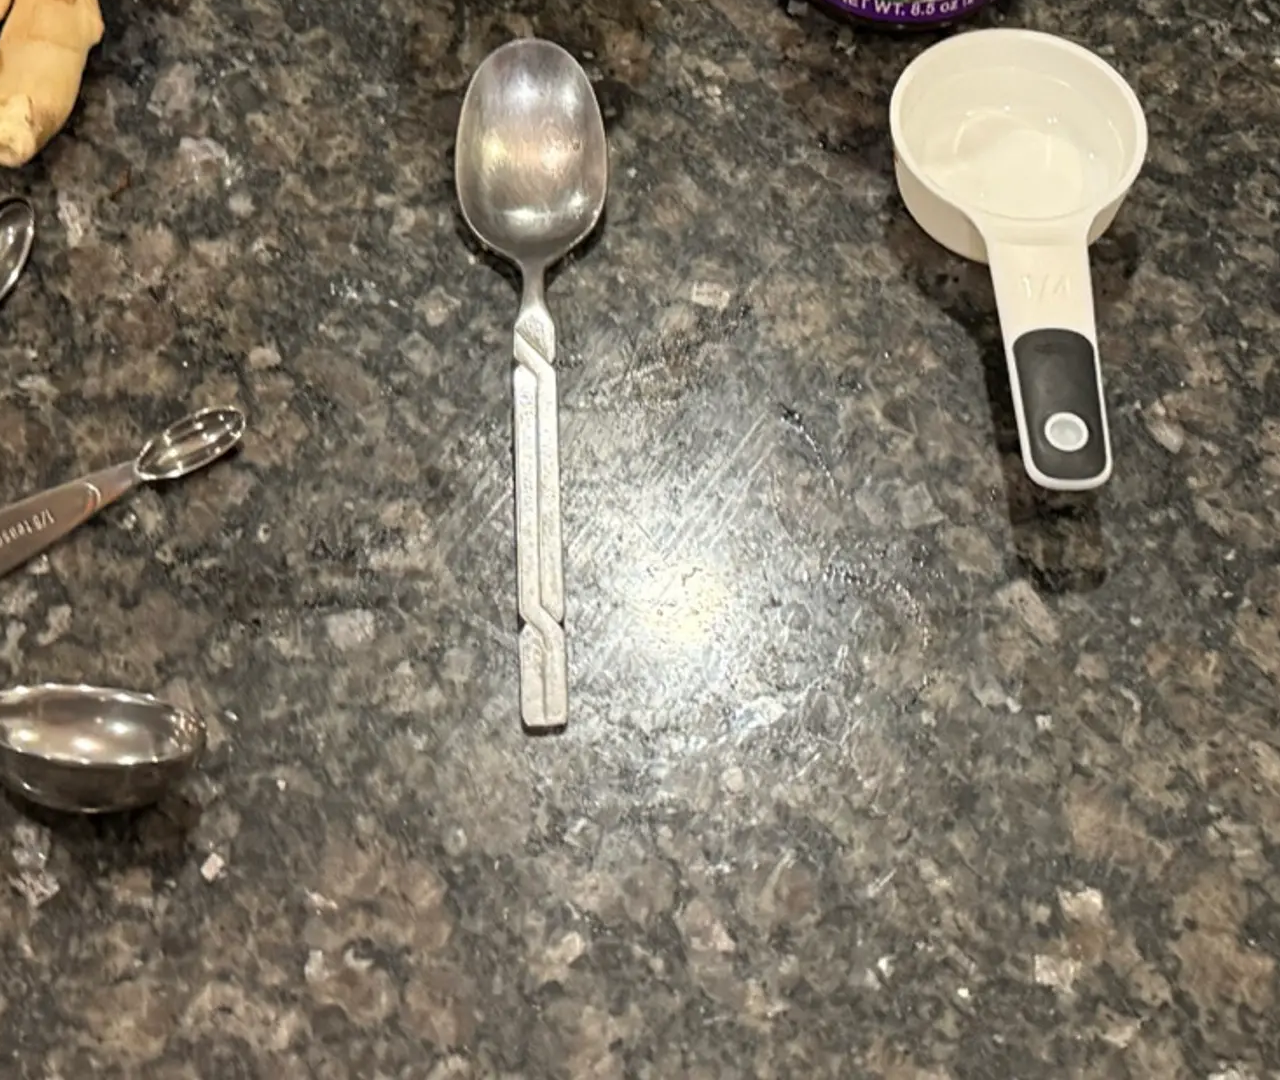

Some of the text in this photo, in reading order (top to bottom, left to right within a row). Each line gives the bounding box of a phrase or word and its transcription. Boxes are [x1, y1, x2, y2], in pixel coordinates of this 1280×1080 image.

[910, 1, 936, 17] 8.5
[940, 0, 959, 13] oz
[1021, 272, 1072, 301] 1/4
